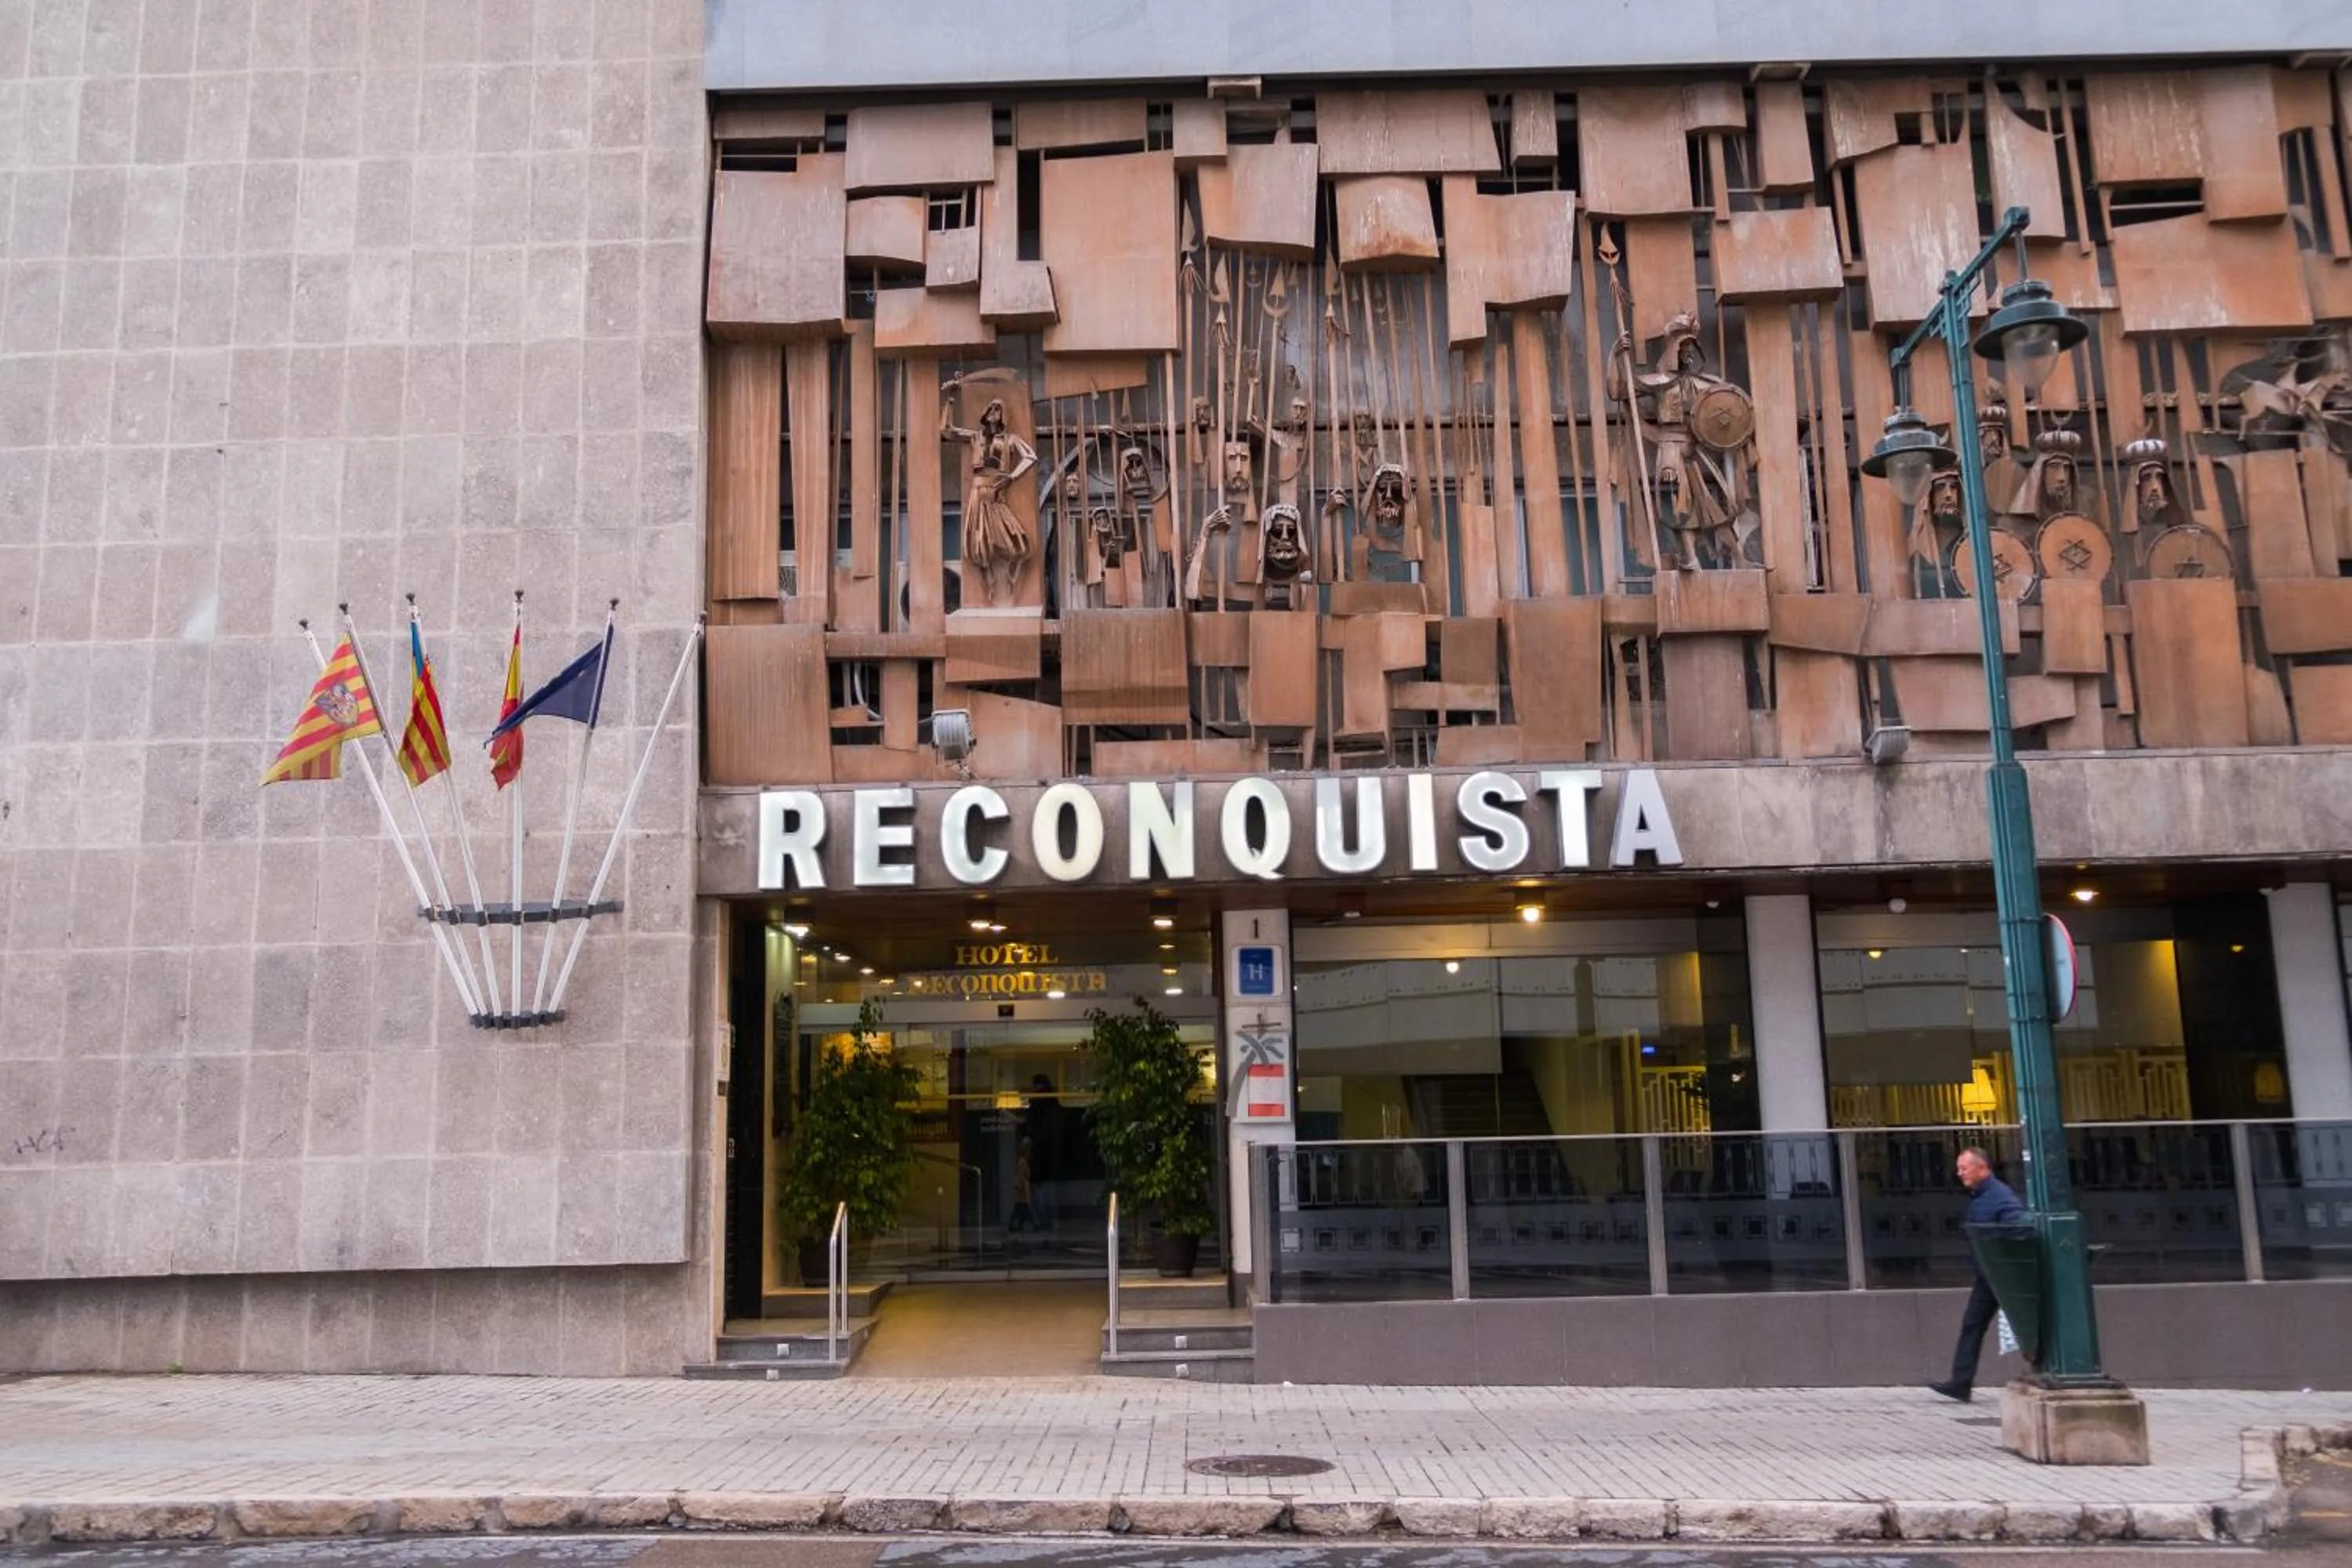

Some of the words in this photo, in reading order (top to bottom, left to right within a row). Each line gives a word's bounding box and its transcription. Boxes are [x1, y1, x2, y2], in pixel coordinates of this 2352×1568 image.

[758, 768, 1683, 889] RECONQUISTA
[954, 943, 1058, 965] HOTEL
[906, 971, 1107, 996] RECONQUISTA
[1248, 964, 1264, 981] H
